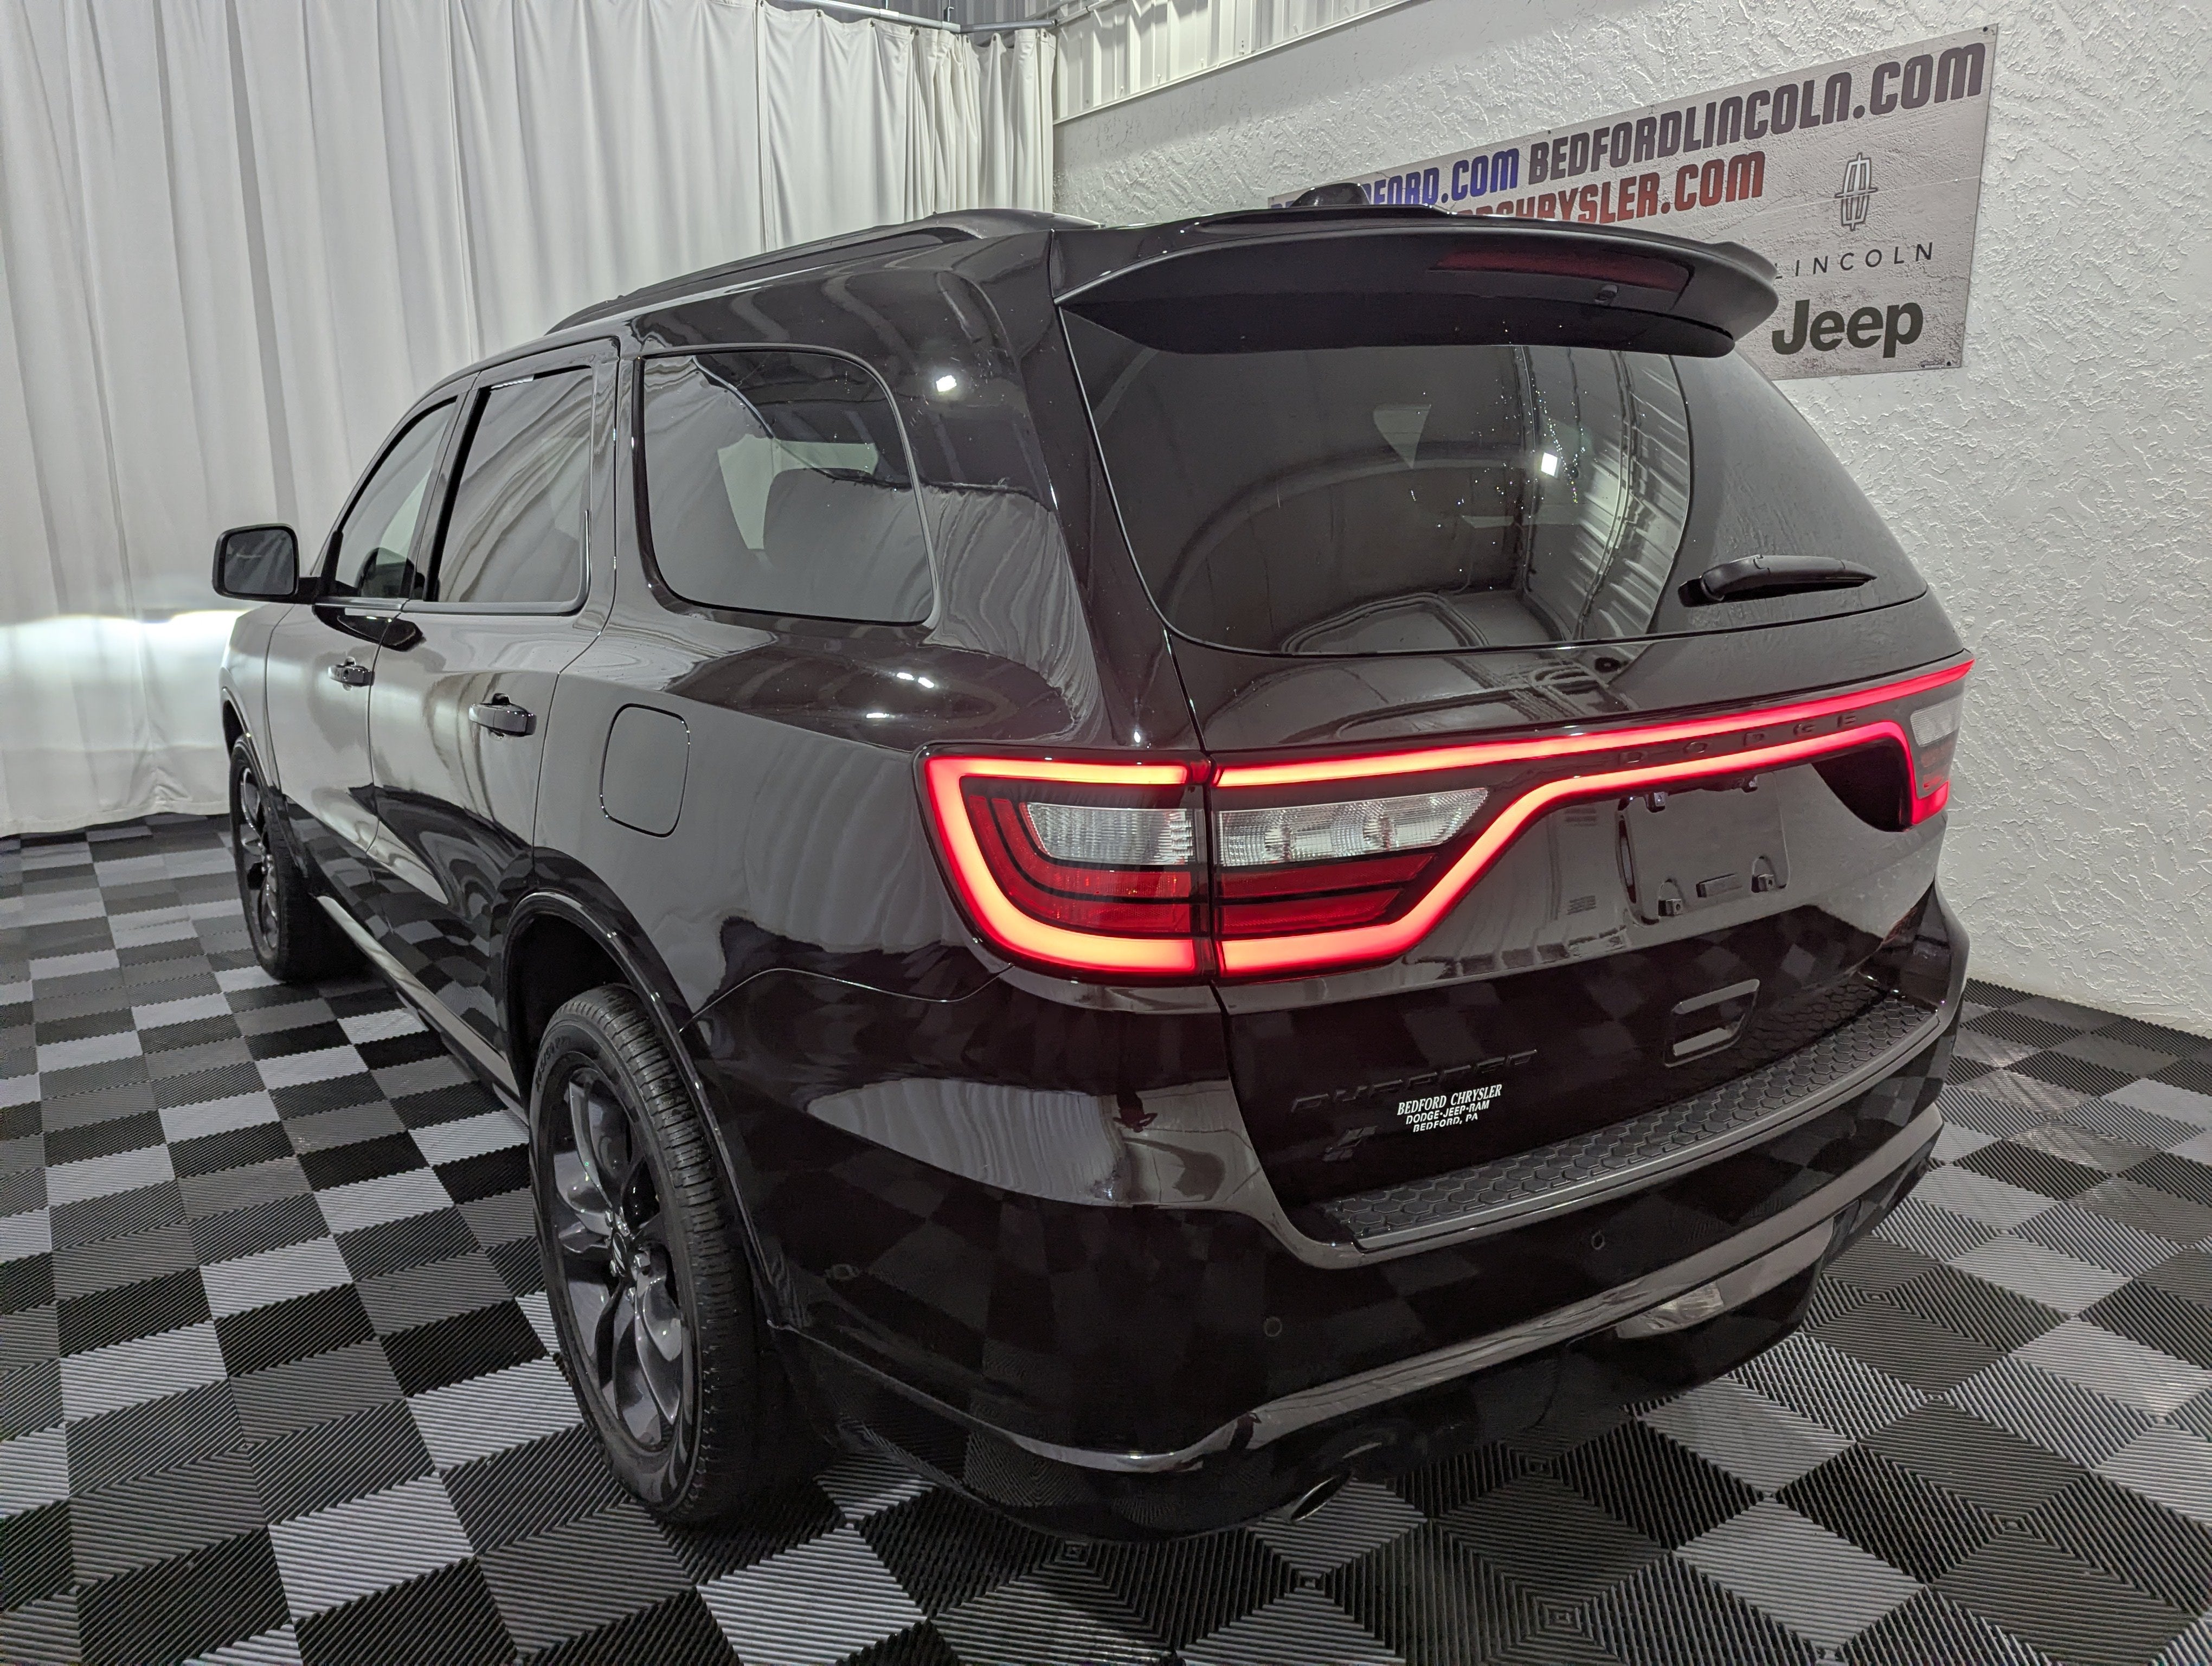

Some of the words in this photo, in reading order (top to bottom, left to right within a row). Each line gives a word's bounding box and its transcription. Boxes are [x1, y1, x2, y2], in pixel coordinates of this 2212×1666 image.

[1772, 299, 1924, 358] Jeep
[1397, 1095, 1447, 1116] BEDFORD
[1450, 1084, 1502, 1106] CHRYSLER
[1412, 1116, 1463, 1133] BEDFORD,
[1465, 1112, 1478, 1122] PA
